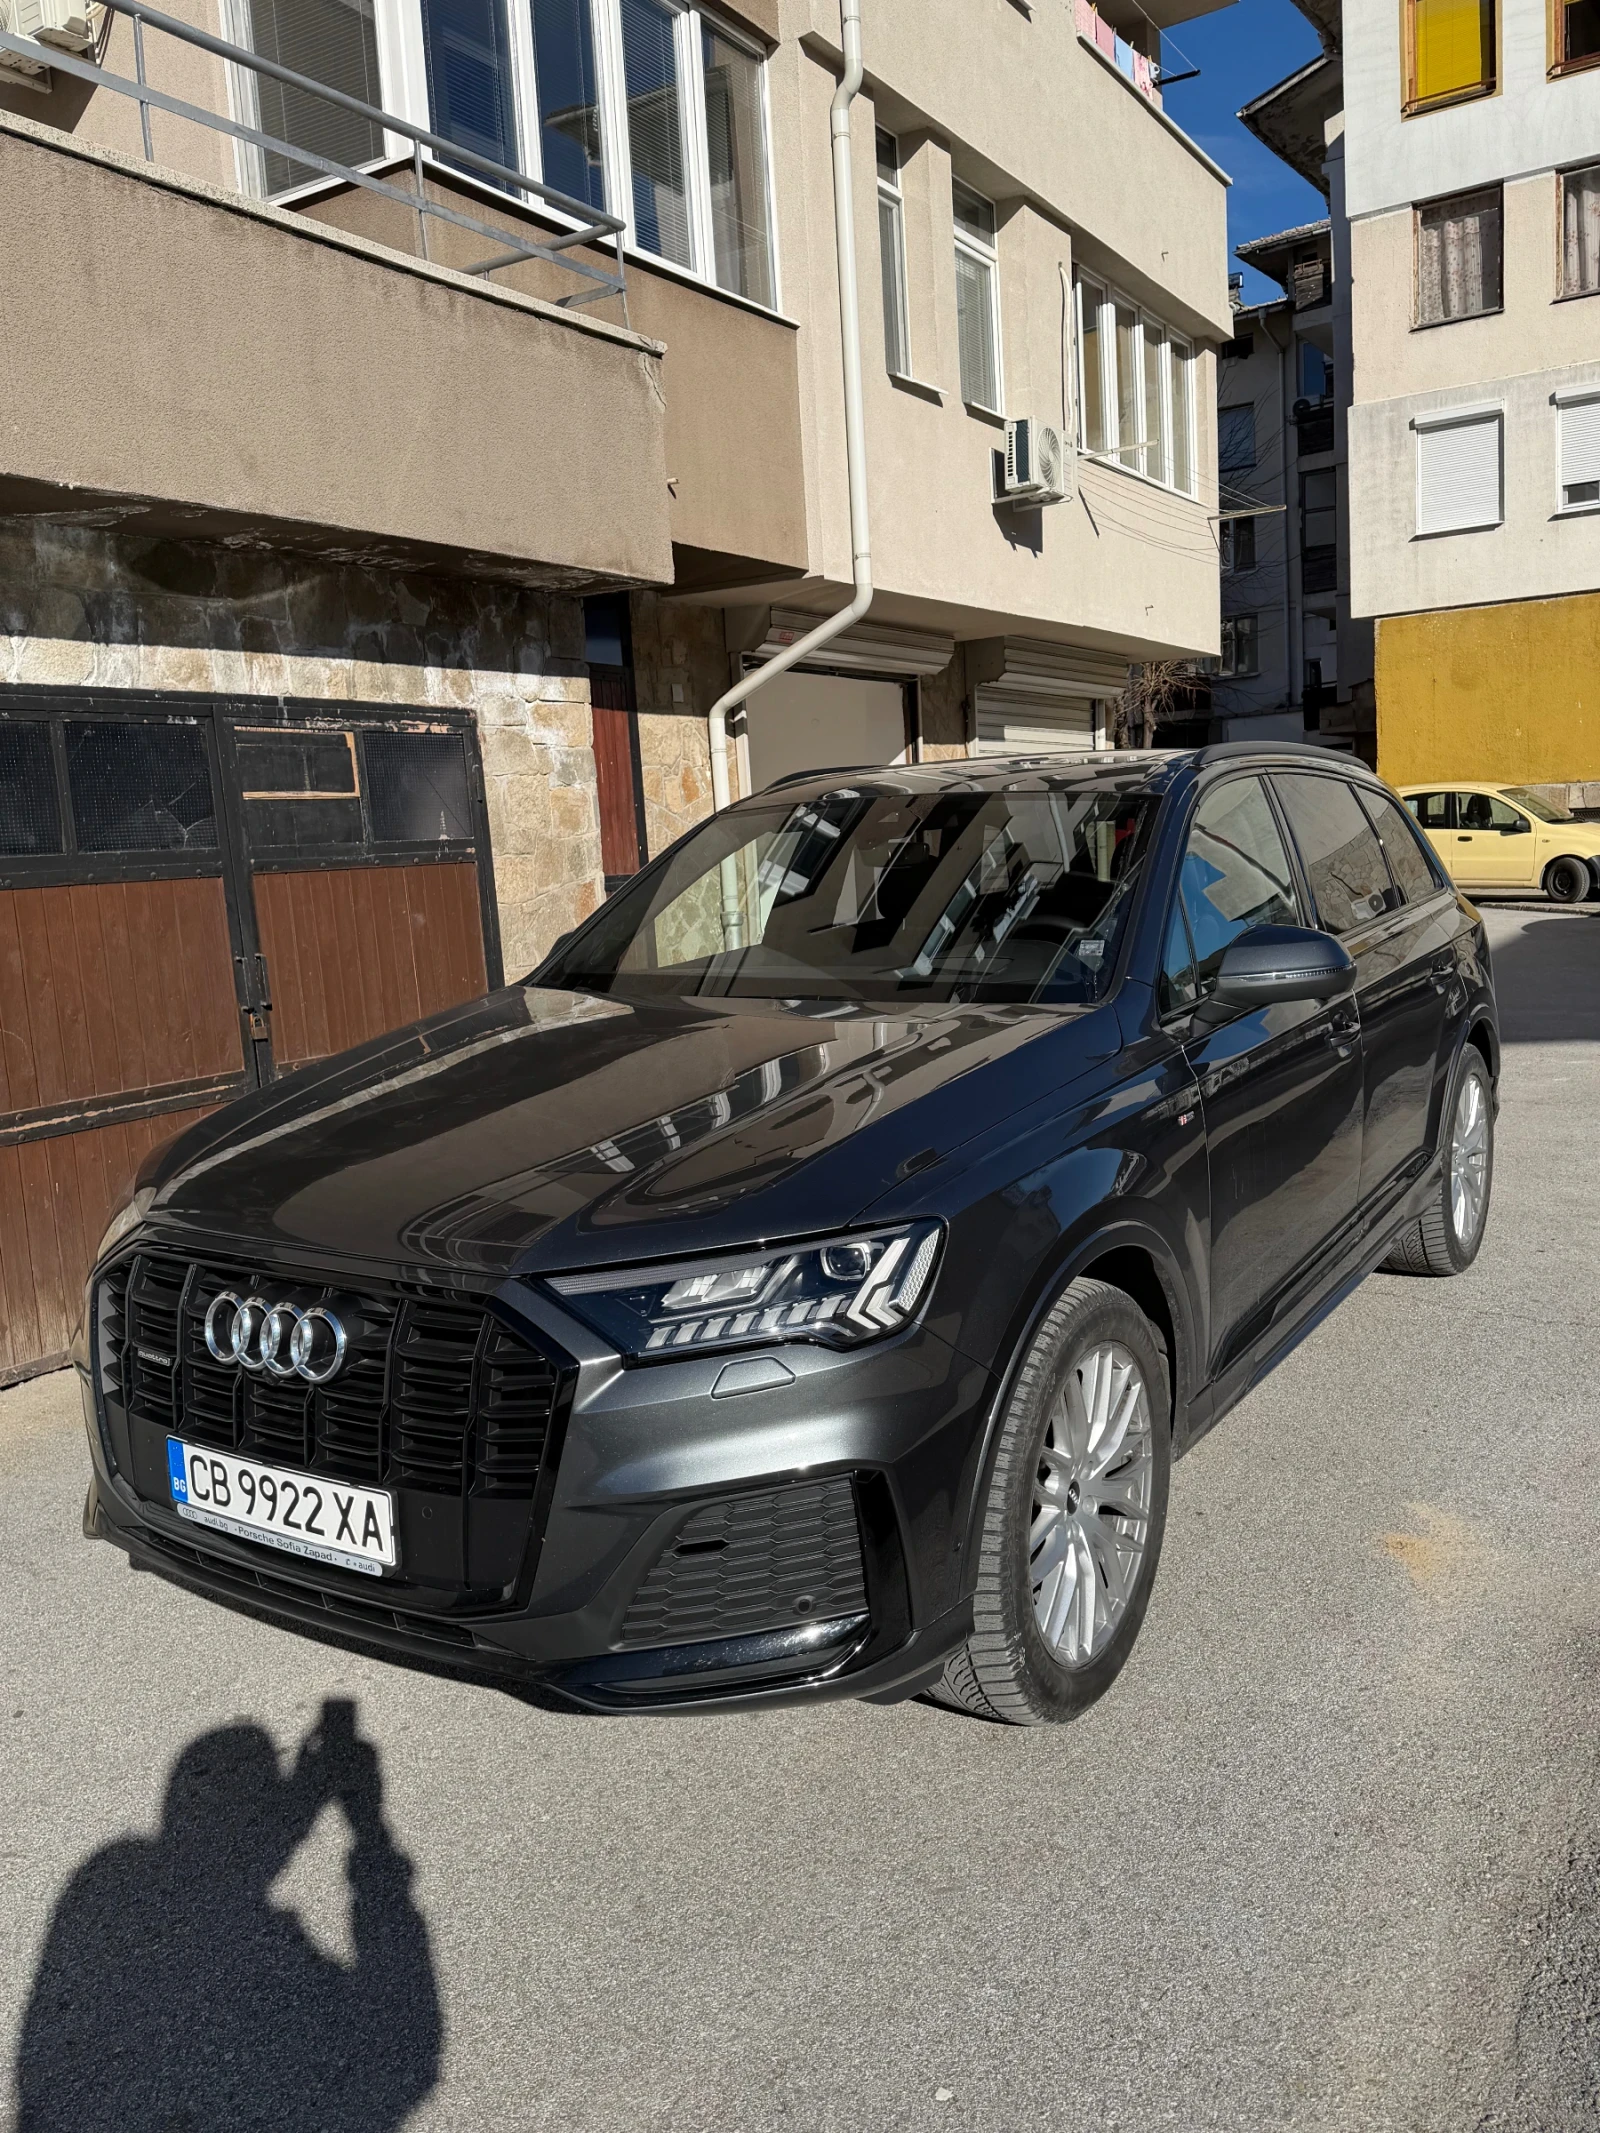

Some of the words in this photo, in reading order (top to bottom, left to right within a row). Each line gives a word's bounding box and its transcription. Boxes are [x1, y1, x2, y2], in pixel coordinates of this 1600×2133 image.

[173, 1478, 187, 1493] BG
[189, 1454, 231, 1507] CB
[238, 1469, 325, 1536] 9922
[332, 1491, 383, 1552] XA
[238, 1526, 275, 1544] Porsche
[276, 1538, 301, 1553] Sofia
[303, 1545, 333, 1561] Zapad
